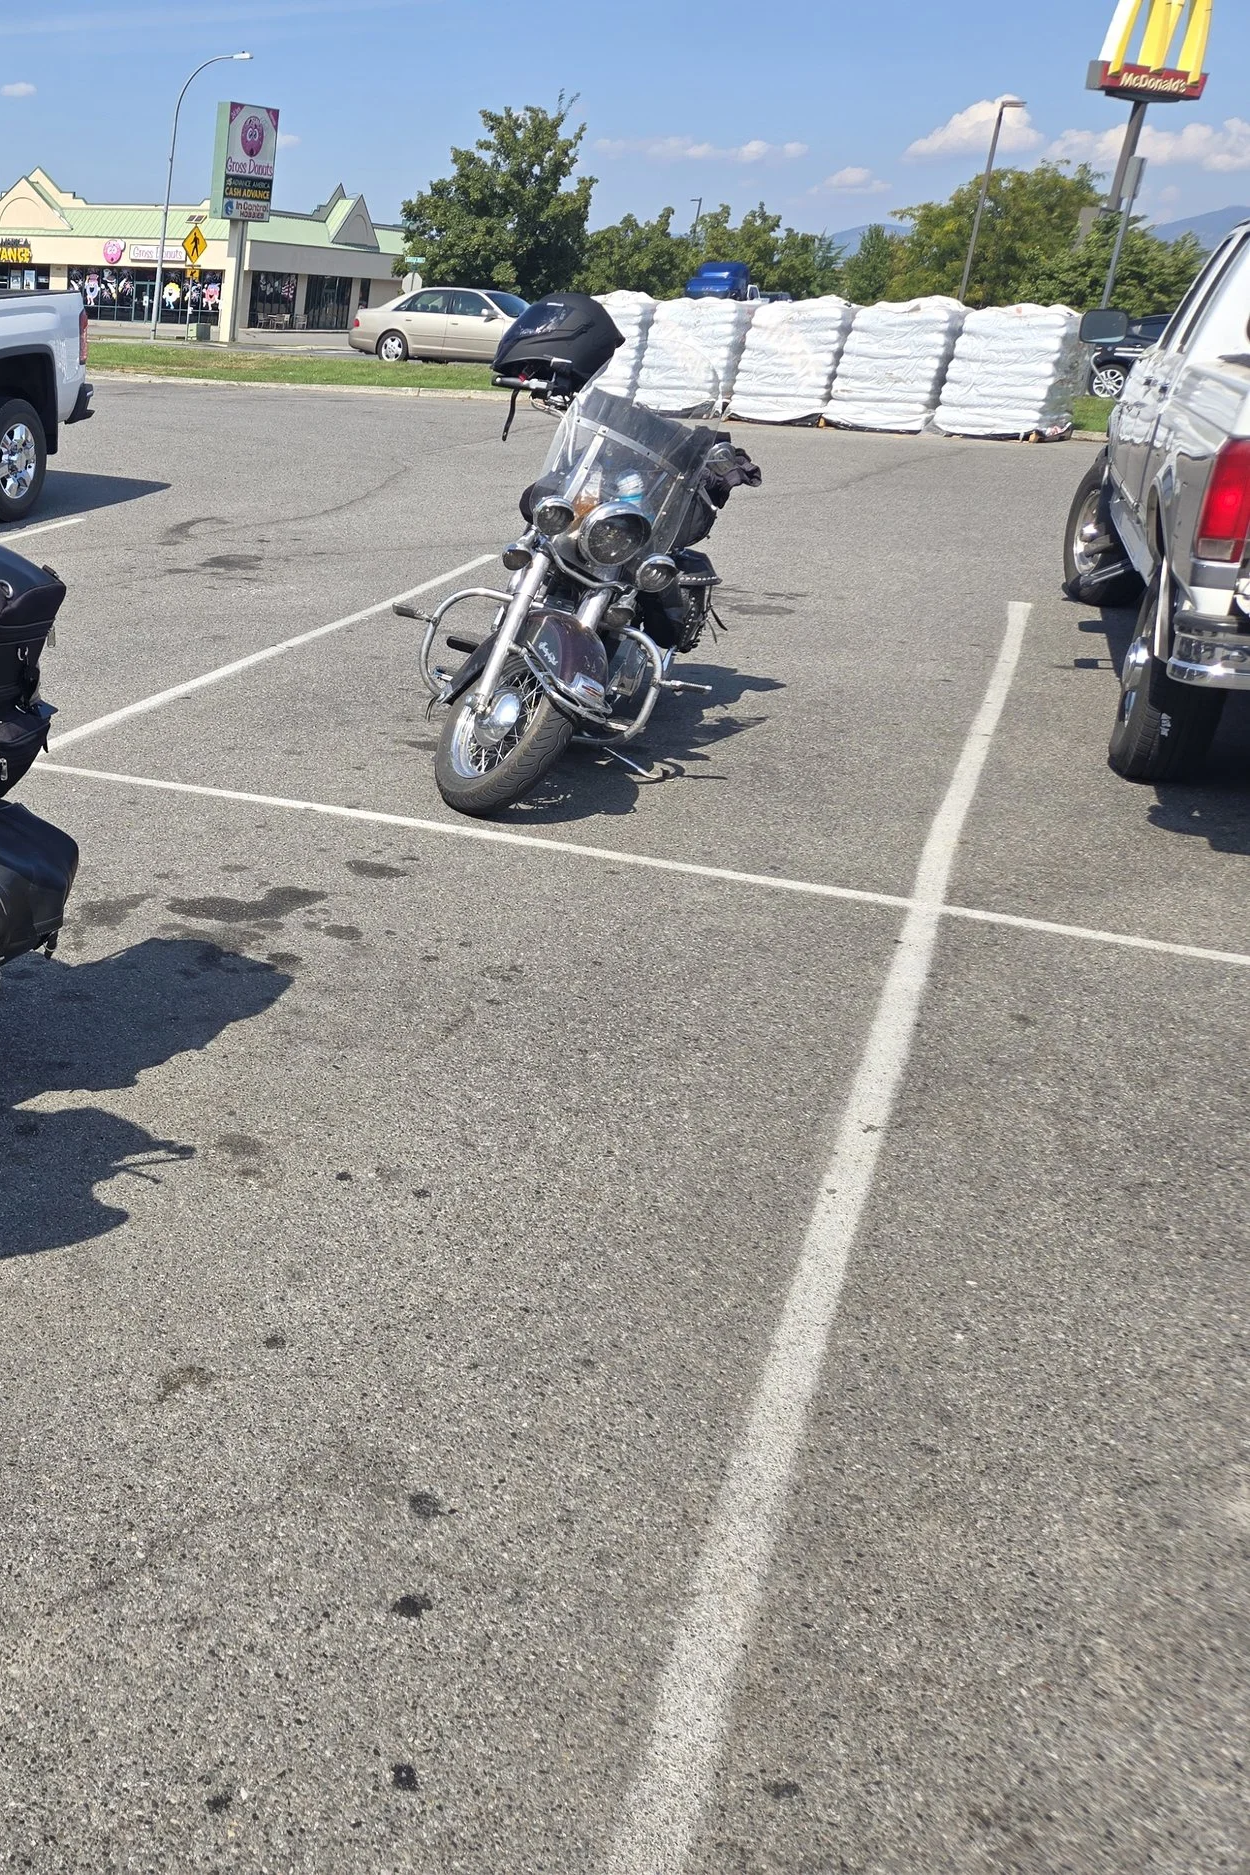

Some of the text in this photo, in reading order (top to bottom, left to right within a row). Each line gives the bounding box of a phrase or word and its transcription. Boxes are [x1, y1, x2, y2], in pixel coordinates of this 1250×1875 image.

[1119, 72, 1186, 93] McDonald's
[226, 157, 273, 176] Gross Donuts
[225, 187, 270, 200] CASH ADVANCE
[236, 201, 269, 213] In Control
[133, 246, 153, 259] Gross
